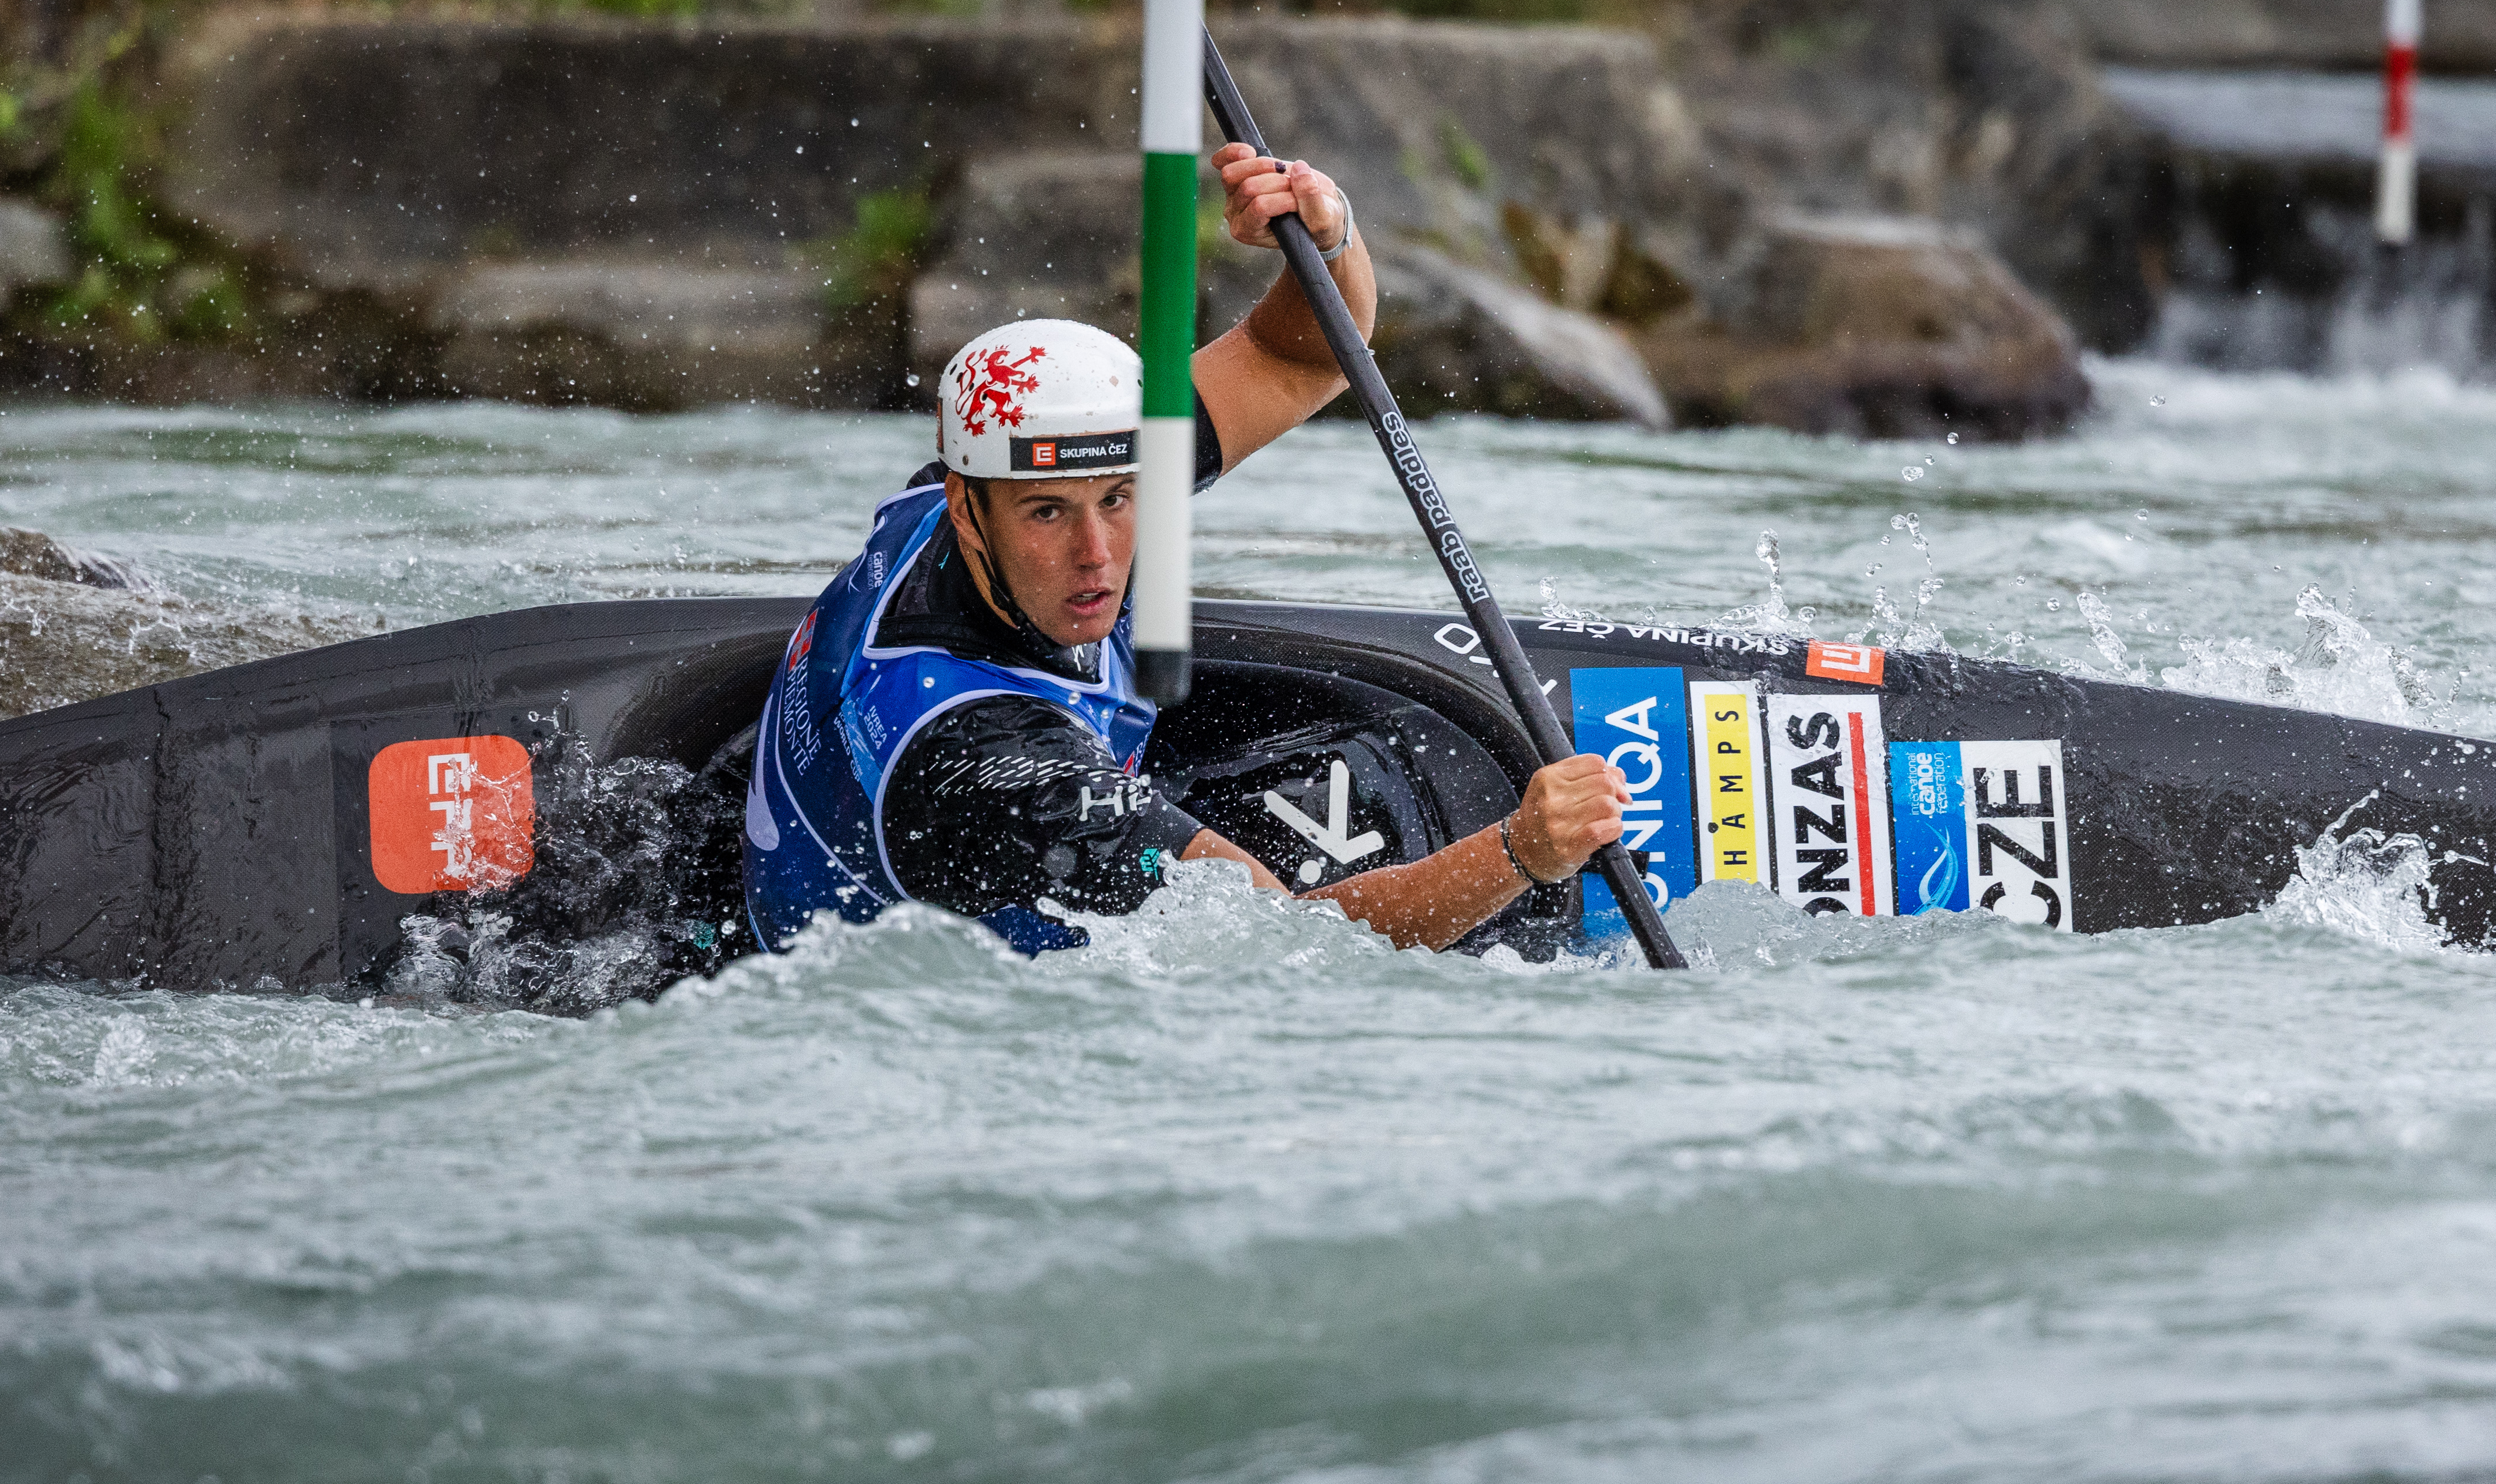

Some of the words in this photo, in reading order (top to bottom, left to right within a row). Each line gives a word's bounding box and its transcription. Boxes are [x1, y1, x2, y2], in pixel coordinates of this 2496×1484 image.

[1060, 445, 1107, 459] SKUPINA
[1108, 443, 1128, 455] ČEZ
[1383, 411, 1455, 529] paddles
[874, 552, 883, 588] canoe
[1441, 531, 1490, 603] raab
[1538, 620, 1615, 639] ČEZ
[1628, 626, 1790, 656] SKUPINA
[784, 668, 810, 776] PIEMONTE
[795, 656, 822, 761] REGIONE
[863, 712, 883, 750] 2024
[869, 705, 887, 743] IVREA
[833, 716, 851, 756] WORLD
[850, 759, 860, 782] CUP
[1905, 751, 1920, 815] international
[1916, 752, 1936, 815] canoe
[1933, 752, 1948, 815] federation
[1973, 765, 2062, 930] CZE
